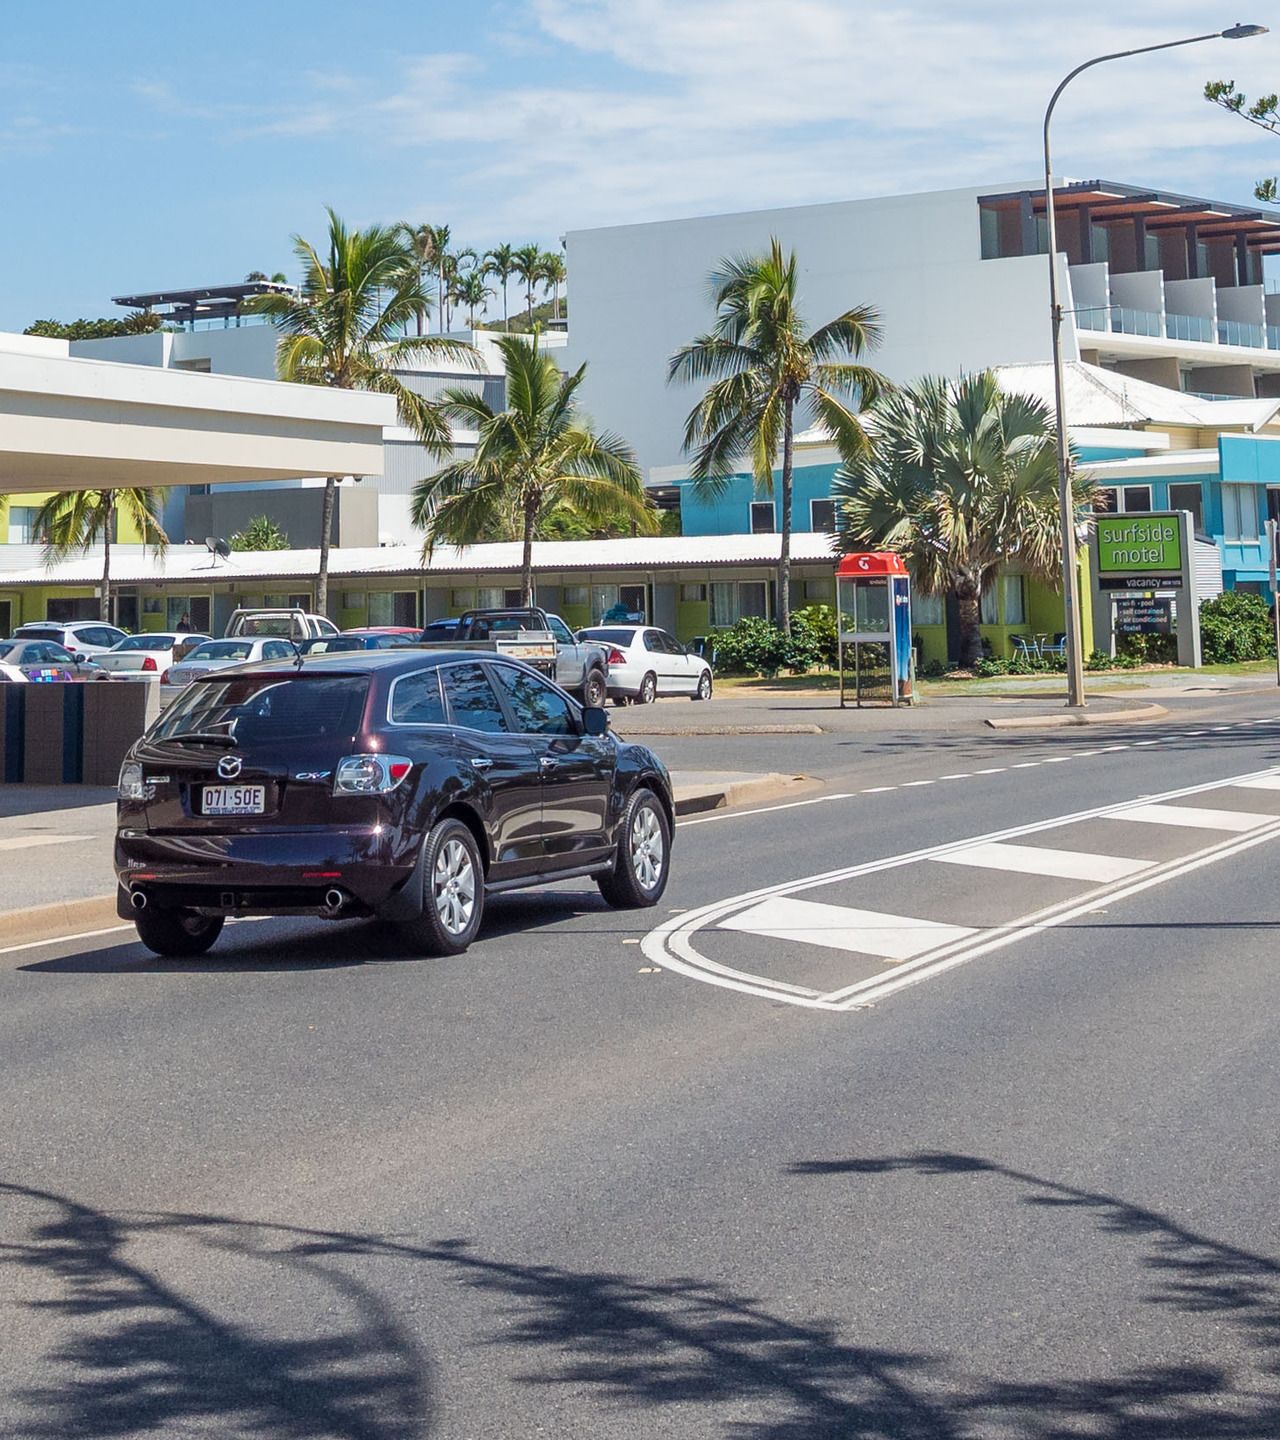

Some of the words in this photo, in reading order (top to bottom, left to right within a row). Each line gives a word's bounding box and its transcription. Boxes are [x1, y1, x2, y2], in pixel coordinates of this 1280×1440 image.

[1103, 523, 1173, 543] surfside
[1112, 544, 1164, 563] motel
[1126, 579, 1160, 588] vacancy
[1141, 599, 1154, 607] pool
